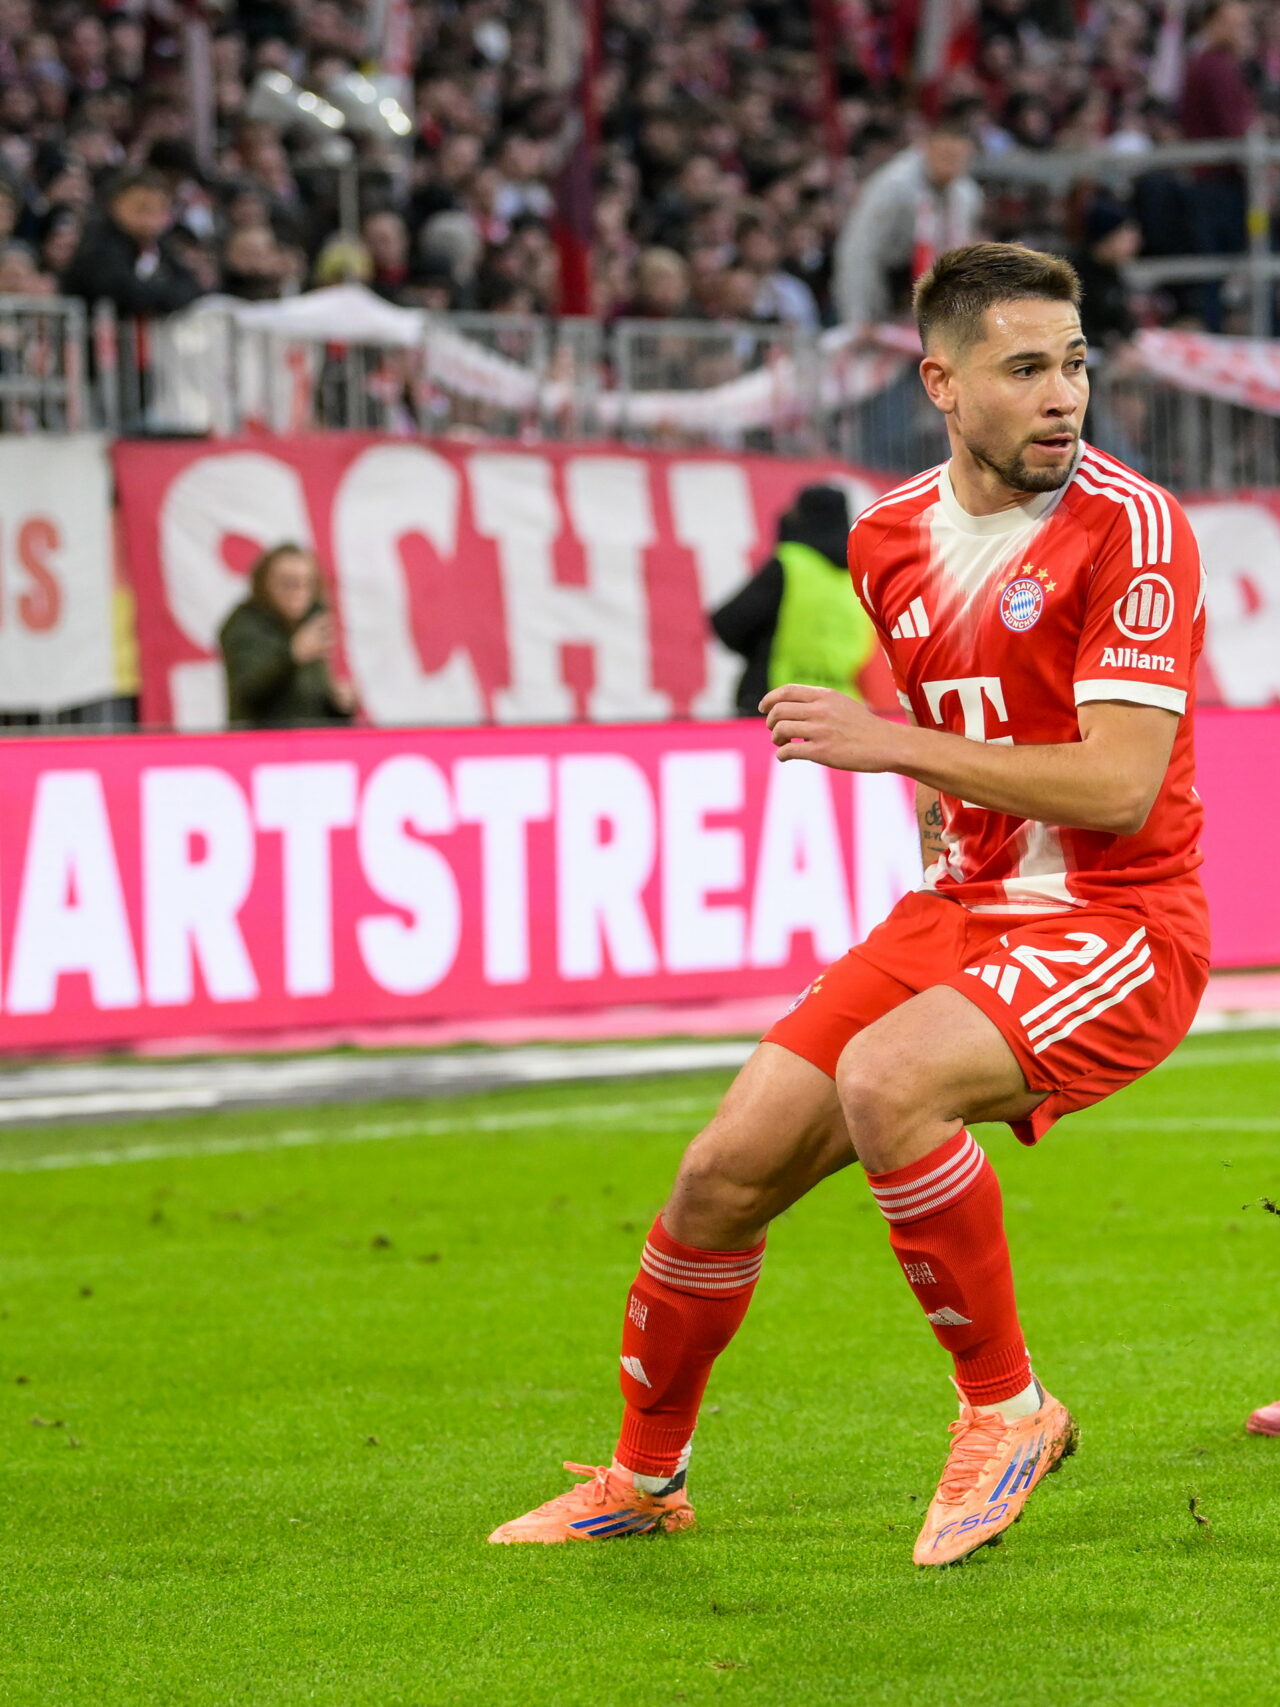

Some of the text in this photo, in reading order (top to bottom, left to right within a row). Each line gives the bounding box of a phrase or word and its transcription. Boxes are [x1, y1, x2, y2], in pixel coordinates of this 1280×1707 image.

[0, 515, 62, 635] S
[1004, 582, 1041, 602] FC BAYERN
[1100, 647, 1175, 673] Allianz
[0, 748, 925, 1015] ARTSTREA
